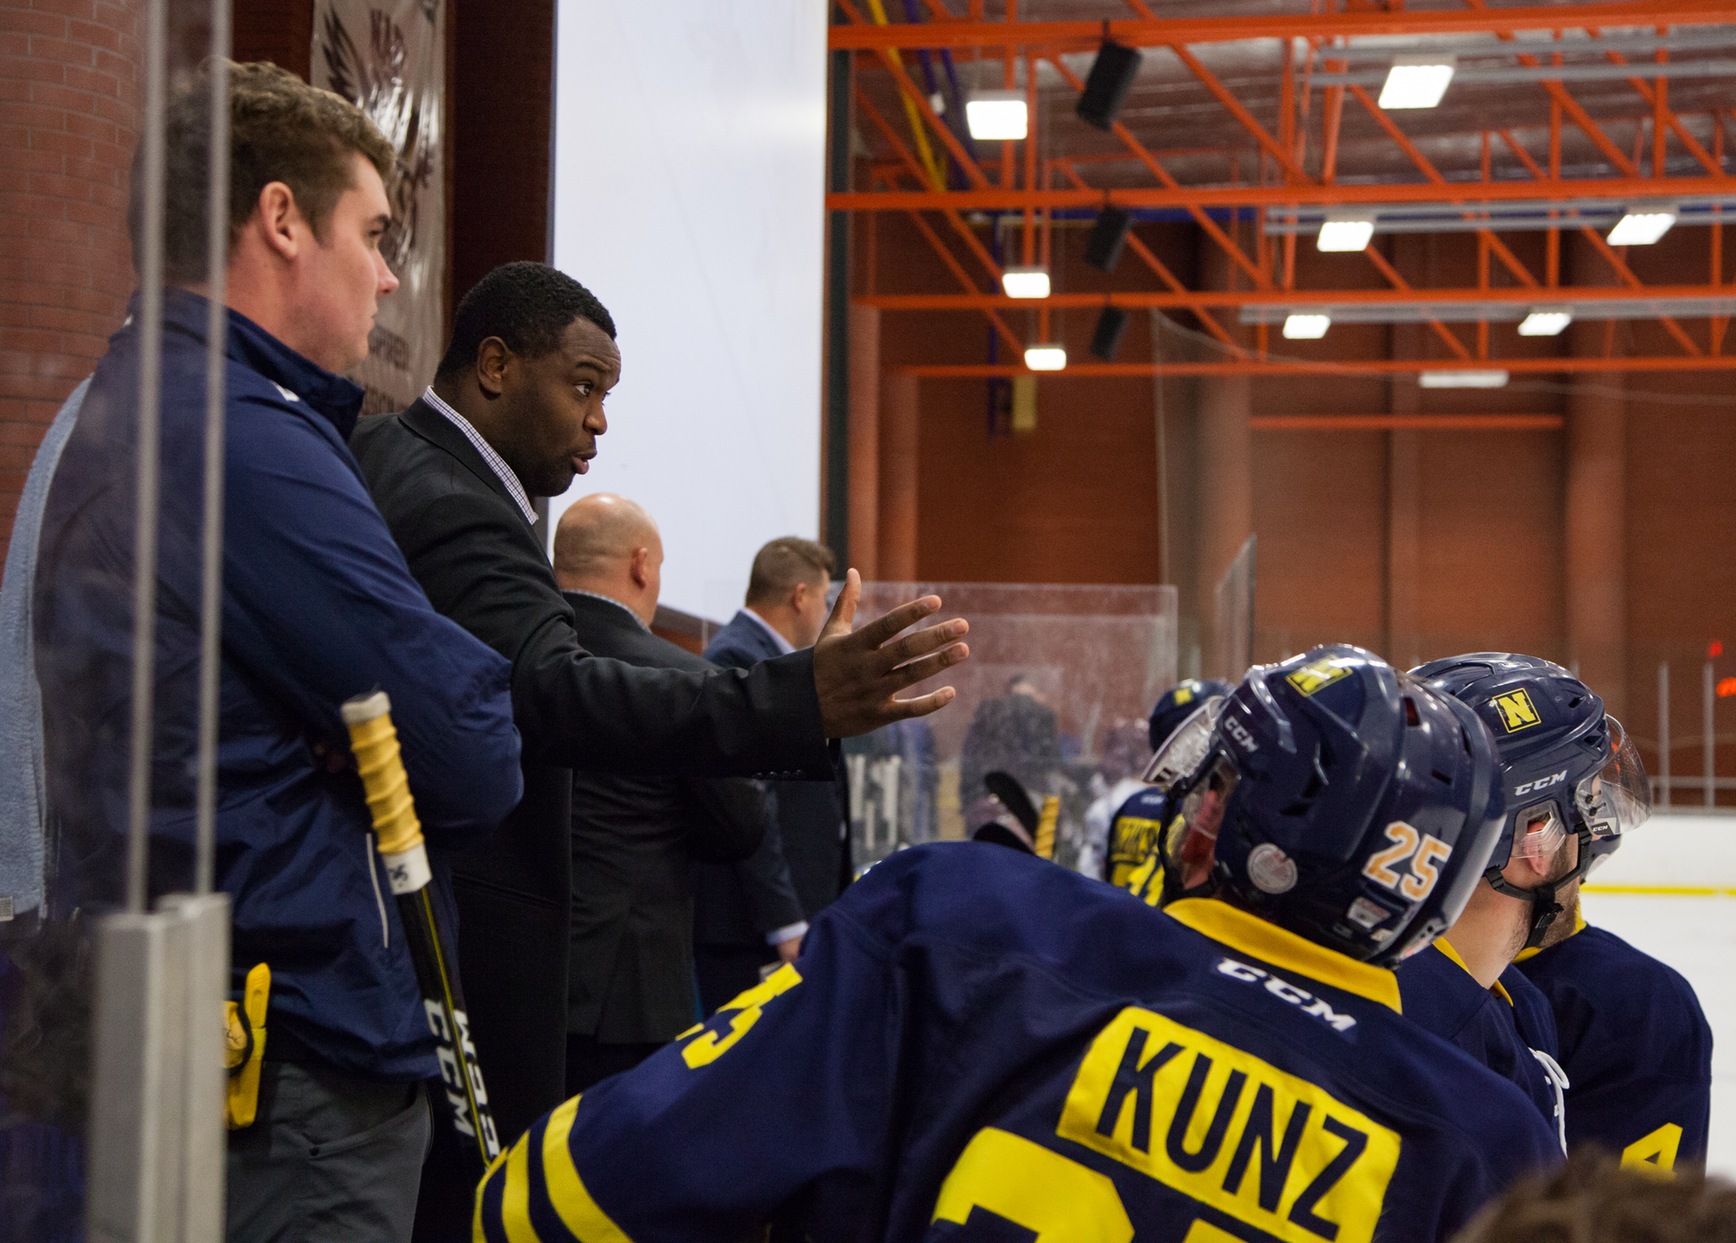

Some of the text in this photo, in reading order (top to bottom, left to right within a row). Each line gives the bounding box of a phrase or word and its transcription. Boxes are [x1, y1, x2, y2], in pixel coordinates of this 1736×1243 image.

[1224, 715, 1260, 754] CCM
[1499, 692, 1536, 729] N
[1514, 770, 1568, 796] CCM
[1591, 823, 1609, 833] CCM
[1361, 820, 1453, 903] 25
[1216, 957, 1357, 1032] CCM
[424, 999, 476, 1138] CCM
[1095, 1026, 1370, 1242] KUNZ
